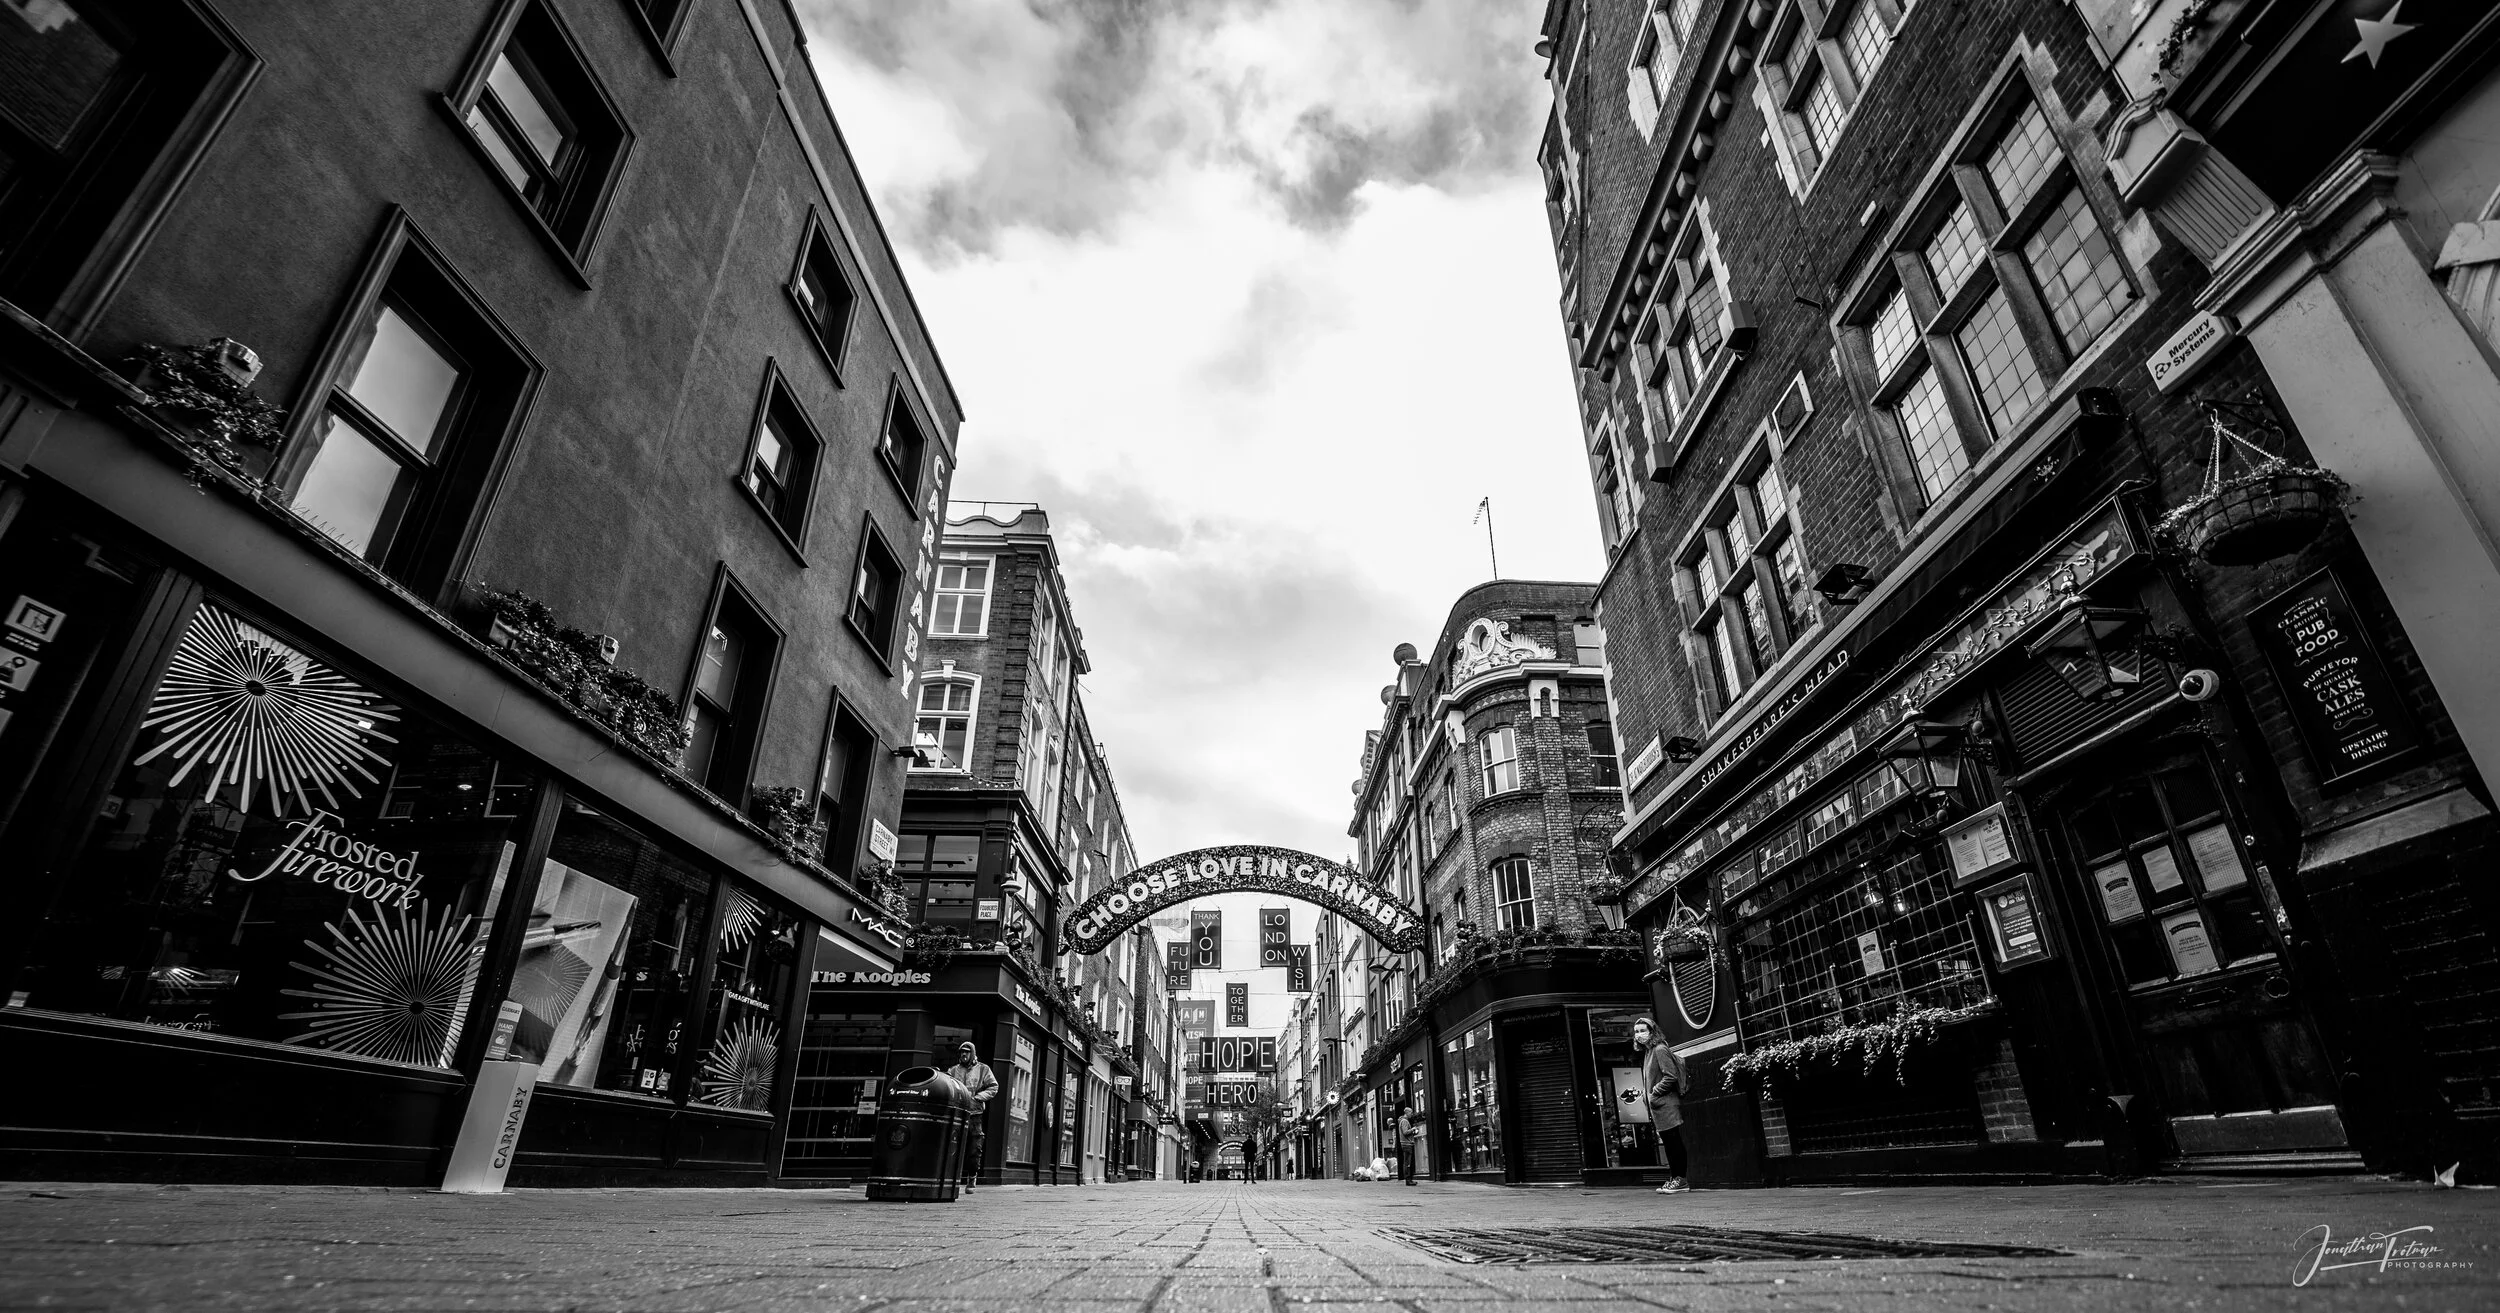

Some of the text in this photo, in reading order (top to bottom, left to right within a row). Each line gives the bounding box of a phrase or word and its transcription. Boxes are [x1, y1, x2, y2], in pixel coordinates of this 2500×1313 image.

[2168, 318, 2210, 358] Mercury
[2172, 327, 2216, 367] Systems
[901, 454, 945, 700] CARNABY
[2277, 596, 2328, 628] CLASSIC
[2295, 628, 2339, 657] FOOD
[2296, 619, 2326, 641] PUB
[2303, 656, 2358, 688] PURVEYOR
[2313, 667, 2354, 691] OF QUALITY
[2316, 674, 2361, 702] CASK
[2324, 687, 2365, 715] ALES
[1701, 693, 1800, 788] SHAKESPEARE'S
[1804, 650, 1849, 694] HEAD
[2341, 729, 2388, 754] UPSTAIRS
[2350, 740, 2387, 760] DINING
[286, 807, 419, 881] Frosted
[1076, 855, 1414, 939] CHOOSE LOVE IN CARNABY
[1199, 921, 1213, 966] YOU
[852, 969, 931, 986] Kooples
[1291, 946, 1307, 990] WISH
[1202, 1041, 1274, 1068] HOPE
[1206, 1084, 1257, 1104] HERO
[493, 1086, 528, 1170] CARNABY
